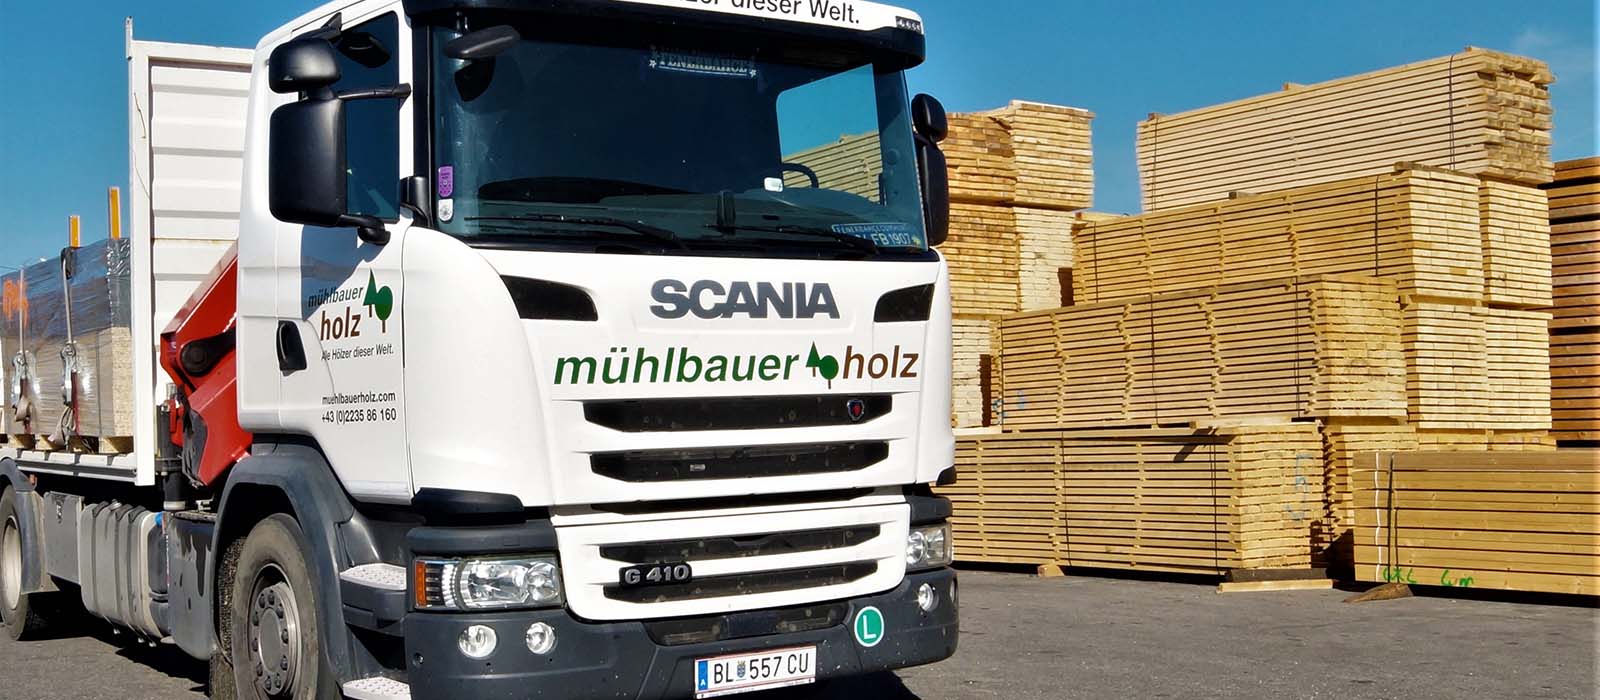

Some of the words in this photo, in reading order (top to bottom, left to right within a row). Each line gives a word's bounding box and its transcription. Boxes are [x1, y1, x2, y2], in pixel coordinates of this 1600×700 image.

[809, 0, 860, 24] Welt.
[889, 233, 911, 245] 1907
[308, 286, 364, 308] mühlbauer
[650, 279, 841, 319] SCANIA
[320, 306, 361, 341] holz
[332, 348, 352, 360] Hölzer
[353, 345, 374, 358] dieser
[375, 343, 394, 355] Welt.
[553, 346, 800, 385] mühlbauer
[842, 345, 920, 380] holz
[322, 390, 396, 405] muehlbauerholz.com
[321, 410, 335, 423] +43
[336, 408, 365, 425] (0)2235
[366, 409, 377, 422] 86
[380, 408, 397, 421] 160
[624, 571, 641, 585] G
[646, 564, 690, 582] 410
[863, 614, 877, 640] L
[713, 662, 734, 685] BL
[749, 656, 782, 680] 557
[787, 653, 809, 675] CU
